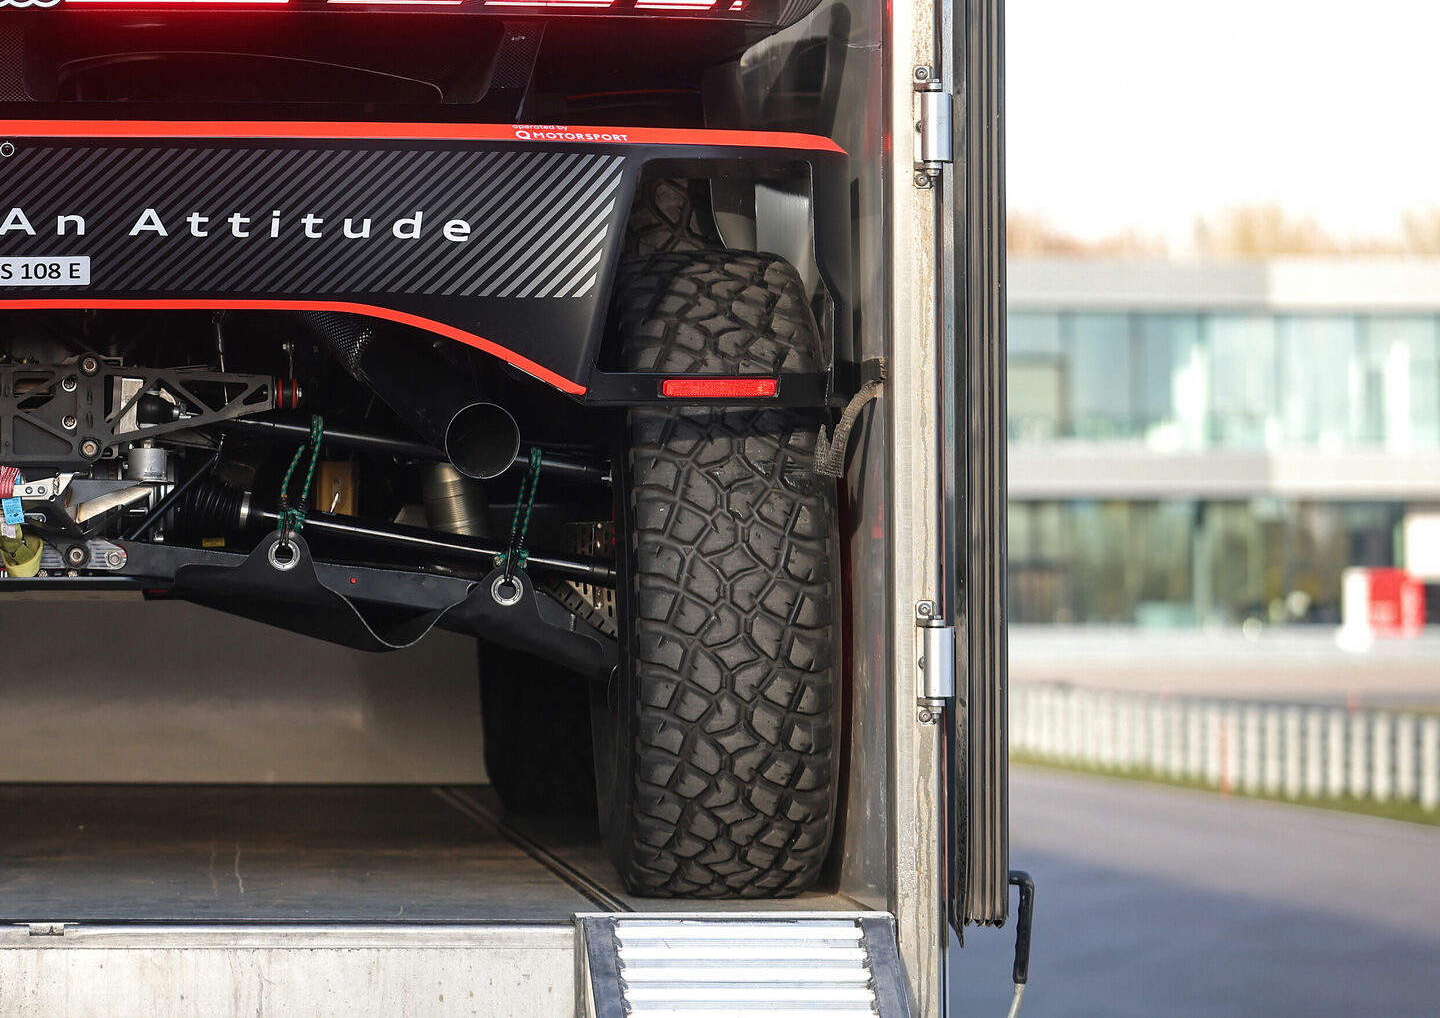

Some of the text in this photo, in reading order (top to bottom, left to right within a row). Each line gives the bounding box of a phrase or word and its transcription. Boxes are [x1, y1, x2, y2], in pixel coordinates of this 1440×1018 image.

[128, 208, 471, 242] Attitude
[21, 263, 62, 280] 108
[69, 262, 81, 279] E
